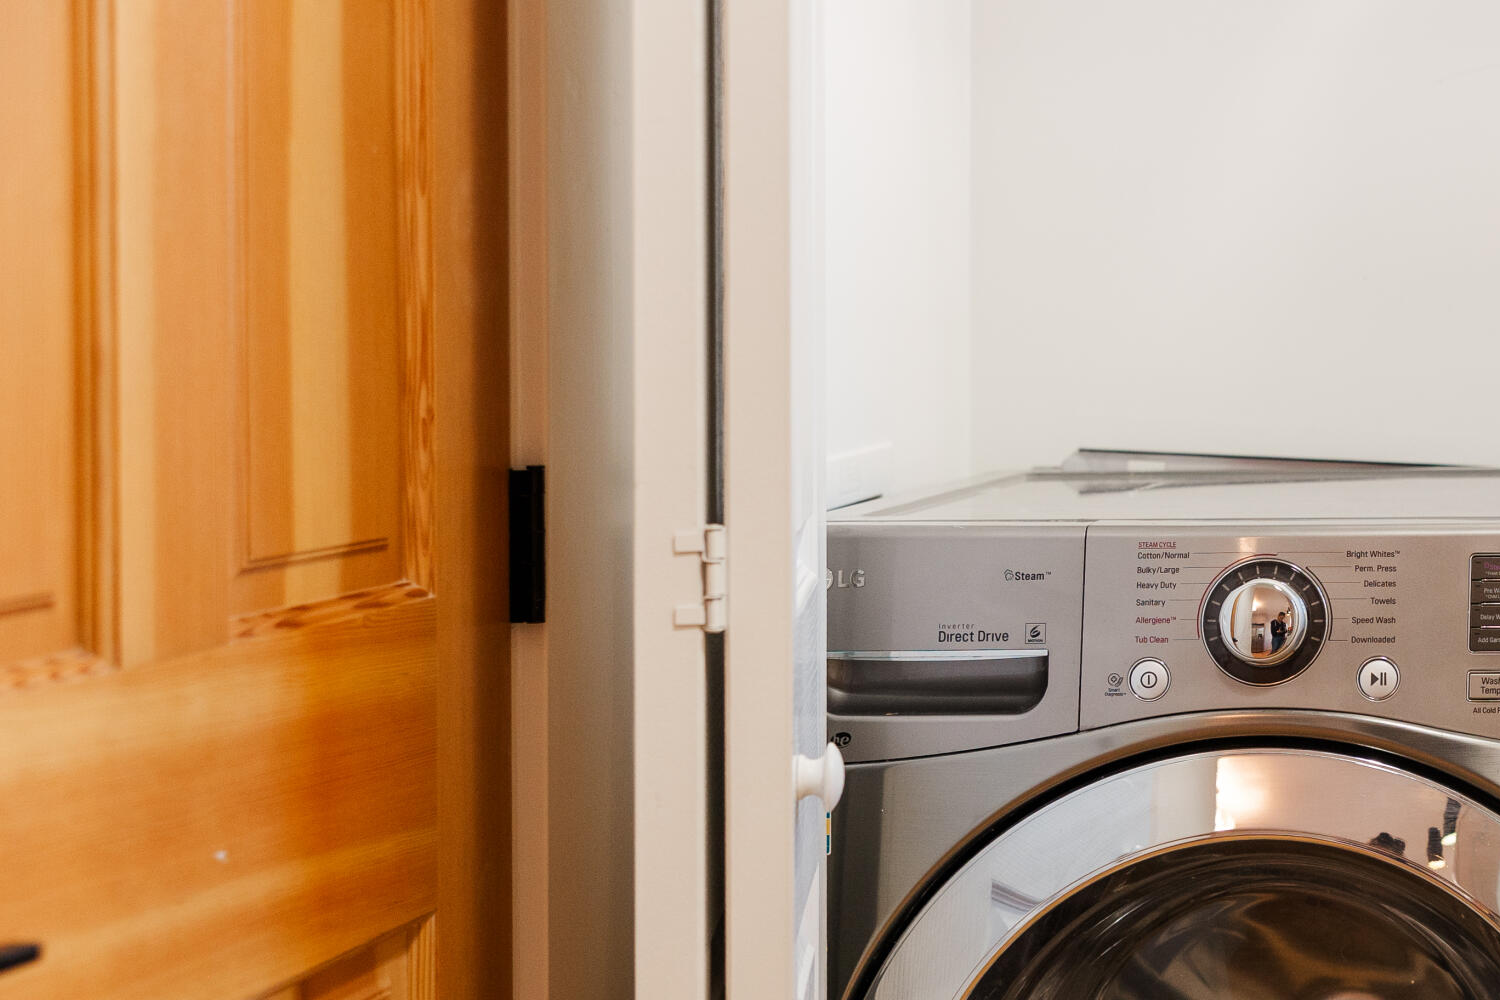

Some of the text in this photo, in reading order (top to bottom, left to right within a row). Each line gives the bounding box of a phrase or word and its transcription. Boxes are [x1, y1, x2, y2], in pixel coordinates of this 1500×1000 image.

[1346, 550, 1367, 559] Bright
[1136, 566, 1180, 574] Bulky/Large
[838, 569, 865, 587] LG
[1136, 581, 1177, 590] Heavy Duty
[1136, 599, 1165, 608] Sanitary
[1370, 597, 1396, 605] Towels
[1351, 616, 1396, 625] Speed Wash
[938, 630, 1009, 643] Direct Drive
